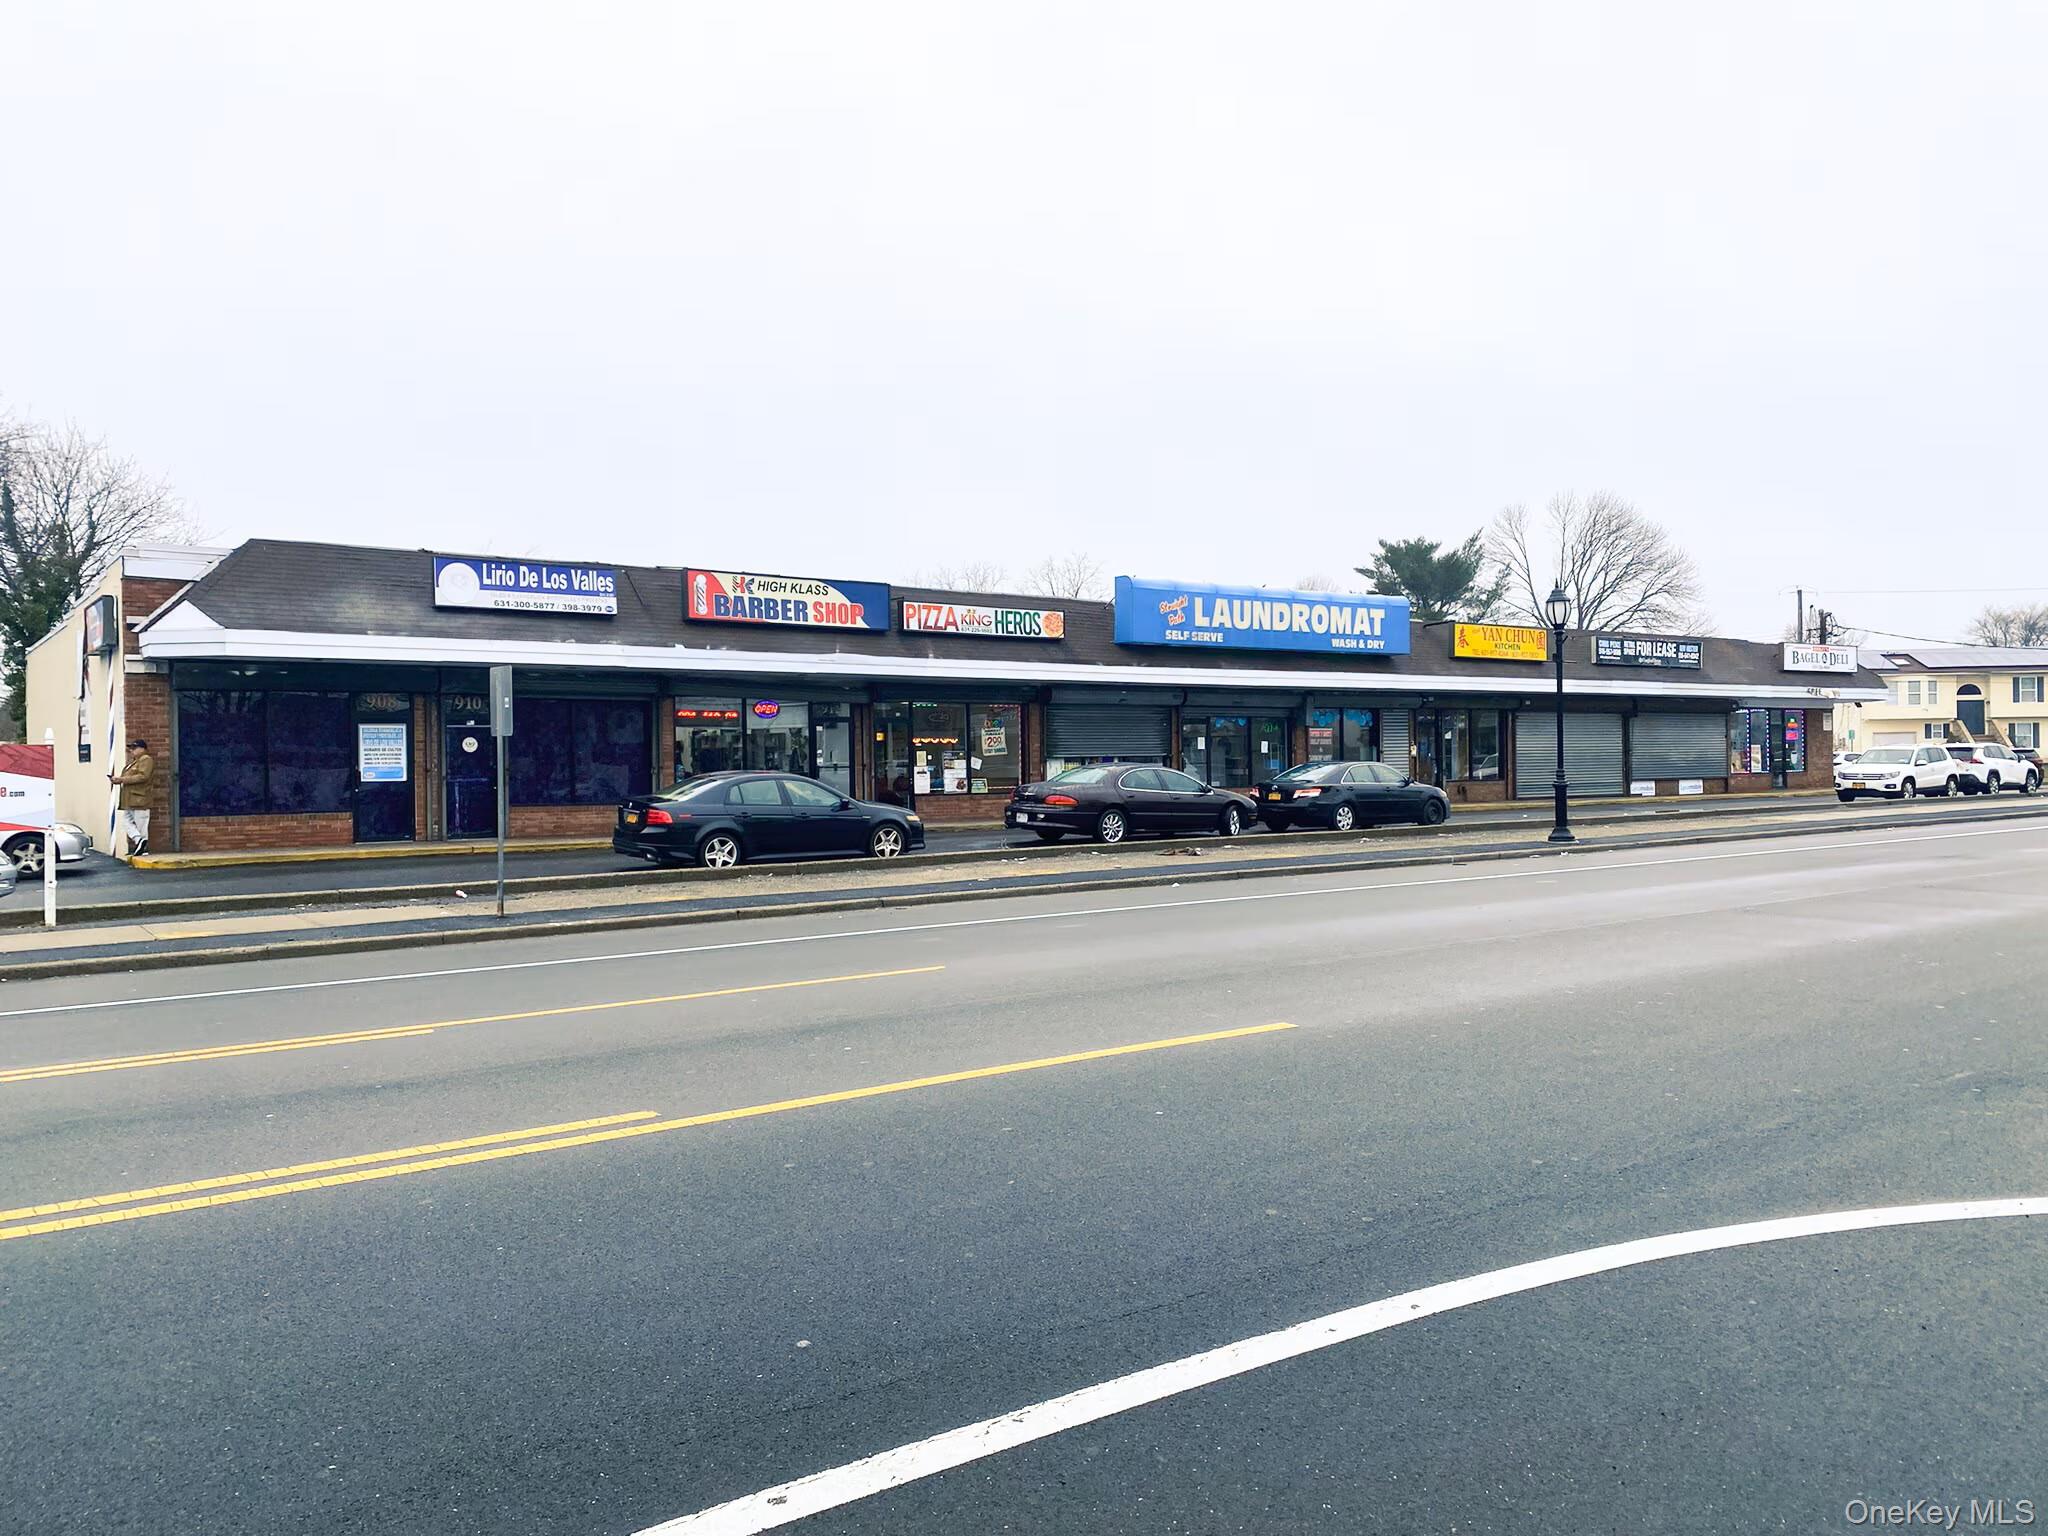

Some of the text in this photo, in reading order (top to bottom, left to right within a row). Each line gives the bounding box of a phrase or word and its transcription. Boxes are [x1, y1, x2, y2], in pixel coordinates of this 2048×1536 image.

[482, 563, 614, 592] Lirio De Los Valles
[757, 580, 829, 596] HIGH KLASS
[714, 593, 865, 625] BARBER SHOP
[905, 603, 959, 631] PIZZA
[1194, 597, 1385, 636] LAUNDROMAT
[961, 612, 992, 627] KING
[994, 610, 1041, 636] HEROS
[1165, 629, 1224, 643] SELF SERVE
[1482, 627, 1536, 644] YAN CHUN
[1331, 638, 1385, 650] WASH & DRY
[1636, 640, 1652, 656] FOR
[1653, 641, 1677, 657] LEASE
[1792, 650, 1820, 664] BAGEL
[1830, 652, 1849, 665] DELI
[367, 695, 396, 710] 908
[455, 696, 481, 710] 910
[754, 704, 779, 714] OPEN
